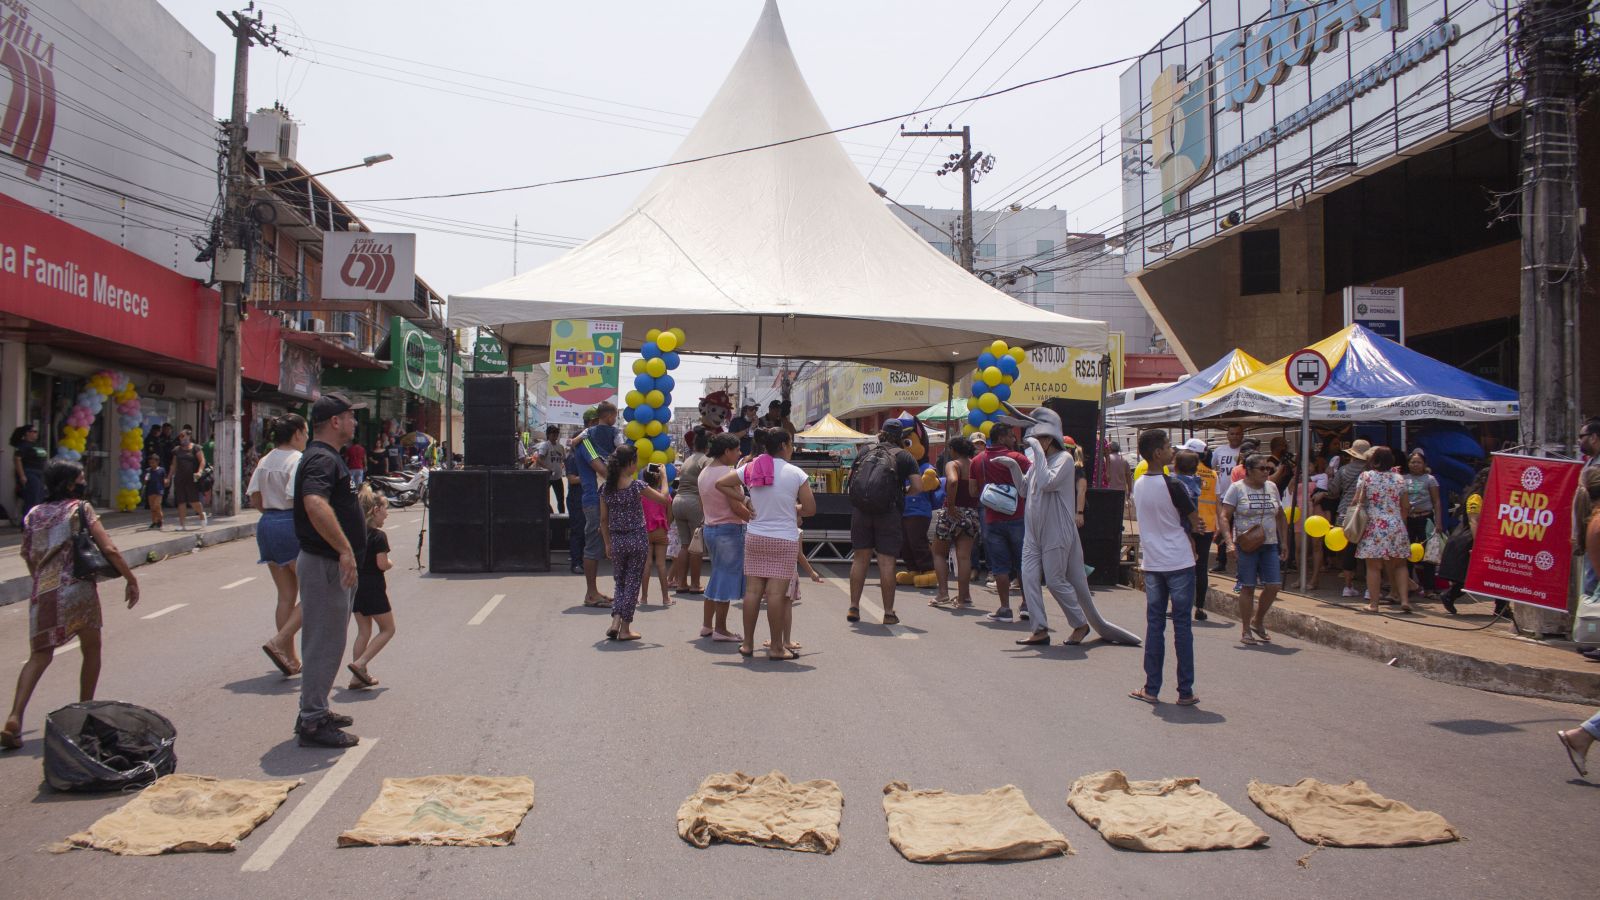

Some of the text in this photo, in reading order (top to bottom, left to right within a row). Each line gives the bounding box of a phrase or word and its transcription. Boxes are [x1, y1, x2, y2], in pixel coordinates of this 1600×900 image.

[350, 244, 393, 254] MILLA
[24, 244, 88, 298] Família
[93, 271, 149, 318] Merece
[556, 348, 614, 367] SÁBADO
[1031, 346, 1066, 366] R$10,00
[889, 370, 919, 385] R$25,00
[1024, 382, 1067, 392] ATACADO
[1221, 455, 1233, 465] EU
[1509, 490, 1549, 510] END
[1497, 503, 1553, 527] POLIO
[1500, 519, 1547, 541] NOW
[1504, 549, 1533, 563] Rotary
[1483, 580, 1546, 599] www.endpolio.org
